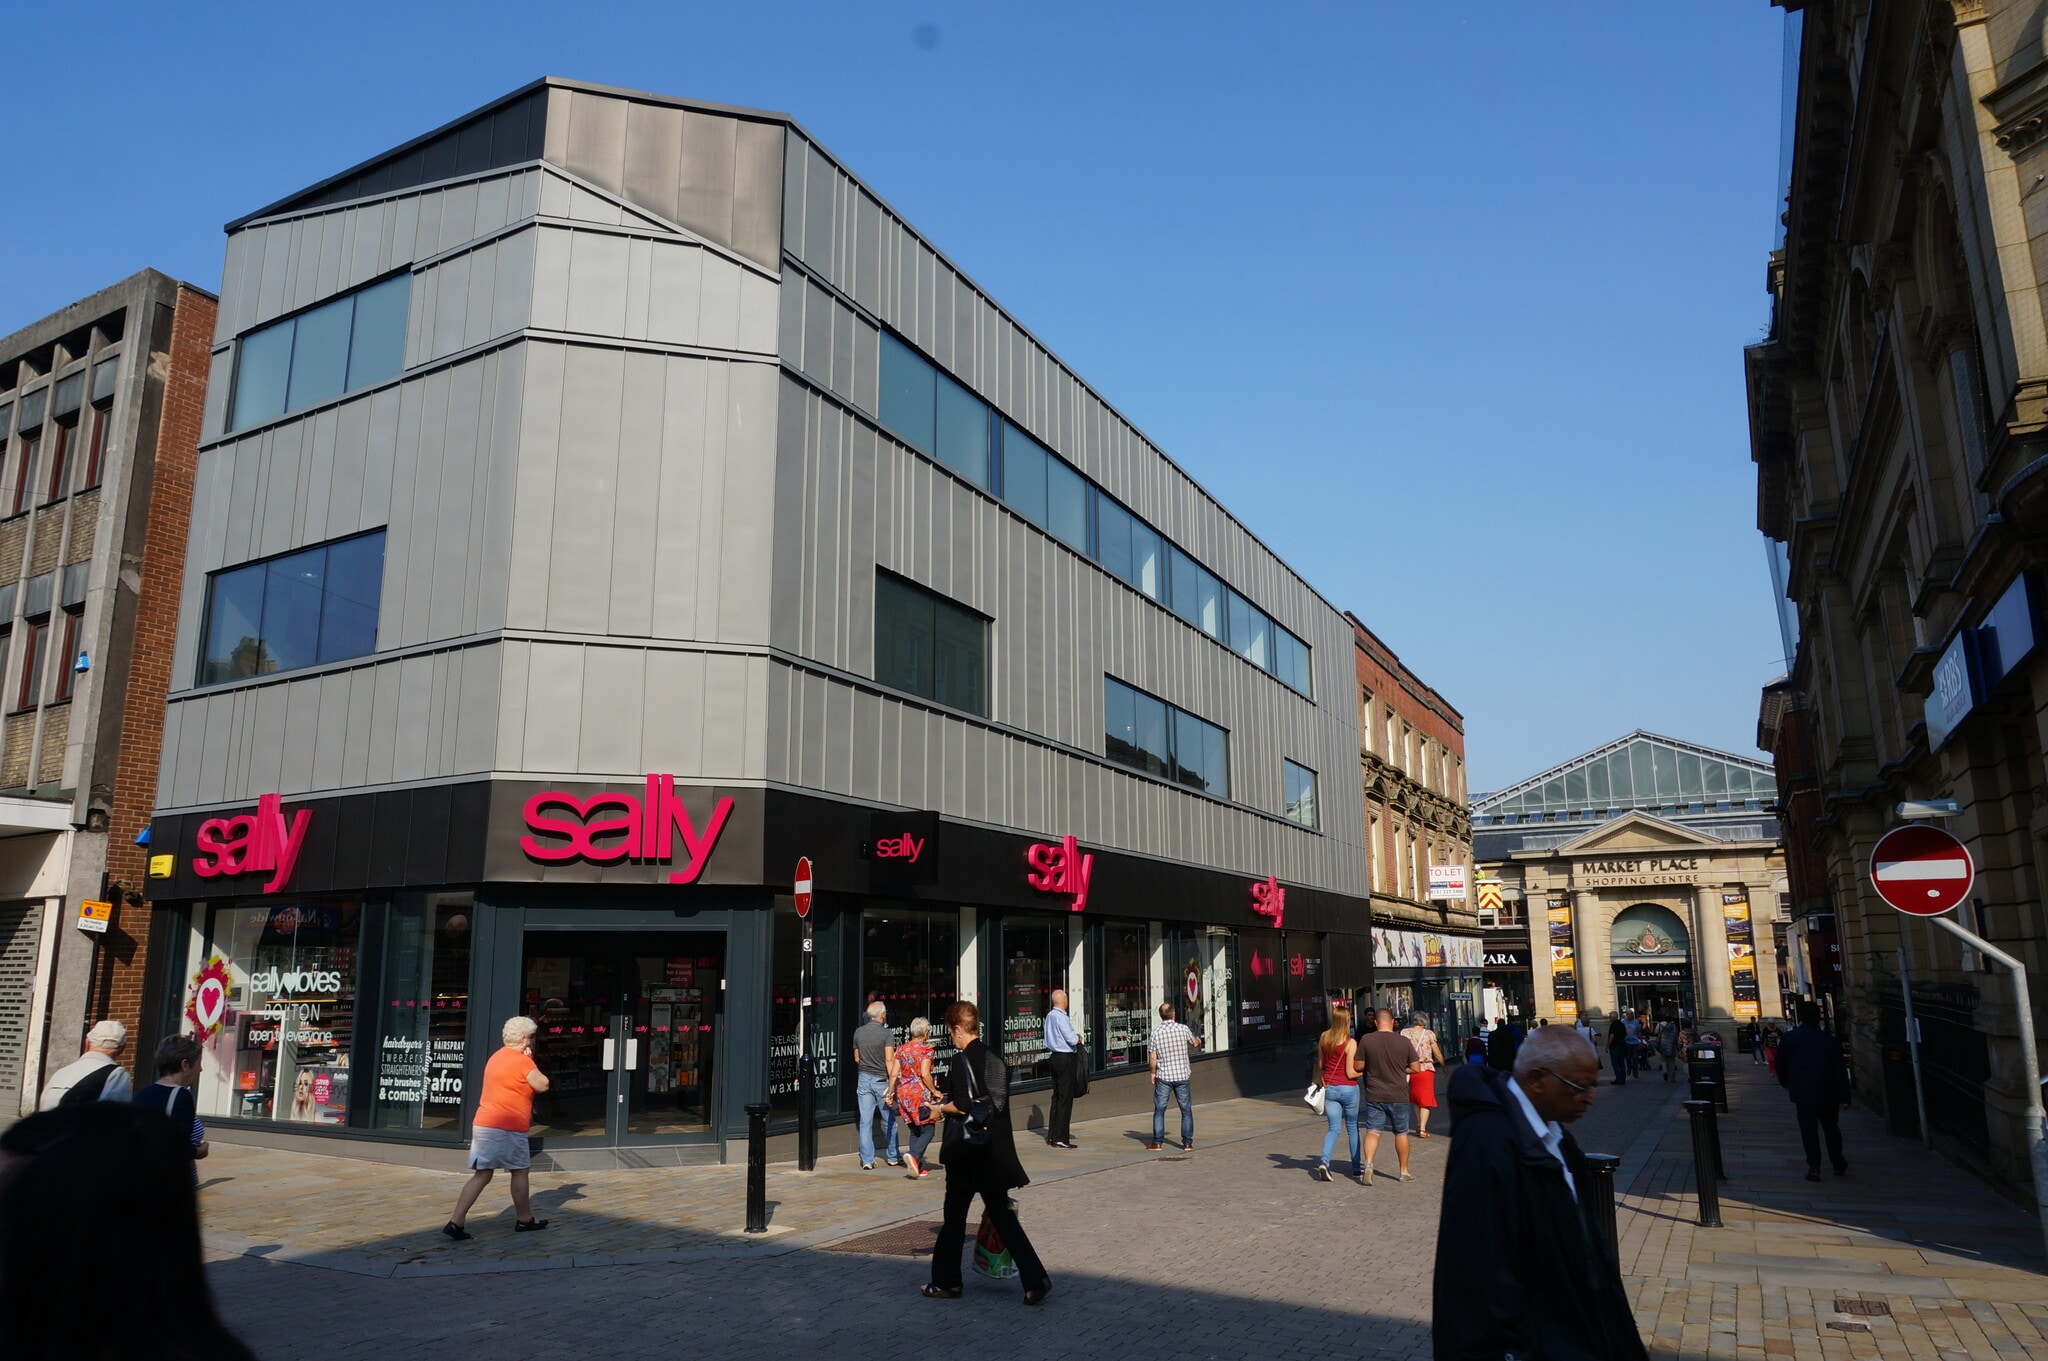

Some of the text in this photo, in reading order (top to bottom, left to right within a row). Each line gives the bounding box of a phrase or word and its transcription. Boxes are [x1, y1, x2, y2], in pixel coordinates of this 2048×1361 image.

[519, 773, 735, 884] sally
[193, 793, 314, 893] sally
[876, 832, 924, 863] sally
[1027, 835, 1093, 911] sally
[1430, 868, 1462, 877] TO LET
[1583, 859, 1698, 874] MARKET PLACE
[1586, 875, 1698, 886] SHOPPING CENTRE
[1251, 876, 1285, 928] sally
[803, 939, 811, 951] 3
[1423, 935, 1441, 954] TOY
[1620, 969, 1687, 977] DEBENHAMS
[251, 966, 341, 999] sally loves
[264, 1003, 321, 1021] BOLTON
[1004, 1016, 1041, 1032] shampoo
[249, 1030, 273, 1044] open
[286, 1030, 333, 1047] everyone
[383, 1035, 424, 1053] hairdryers
[433, 1041, 465, 1051] HAIRSPRAY
[1004, 1039, 1047, 1053] HAIR TREATME
[382, 1051, 423, 1063] tweezers
[433, 1053, 464, 1062] TANNING
[381, 1063, 422, 1076] STRAIGHTENERS
[380, 1076, 422, 1088] hair brushes
[431, 1069, 462, 1093] afro
[821, 1075, 837, 1088] skin
[379, 1087, 421, 1102] & combs
[430, 1091, 462, 1105] haircare
